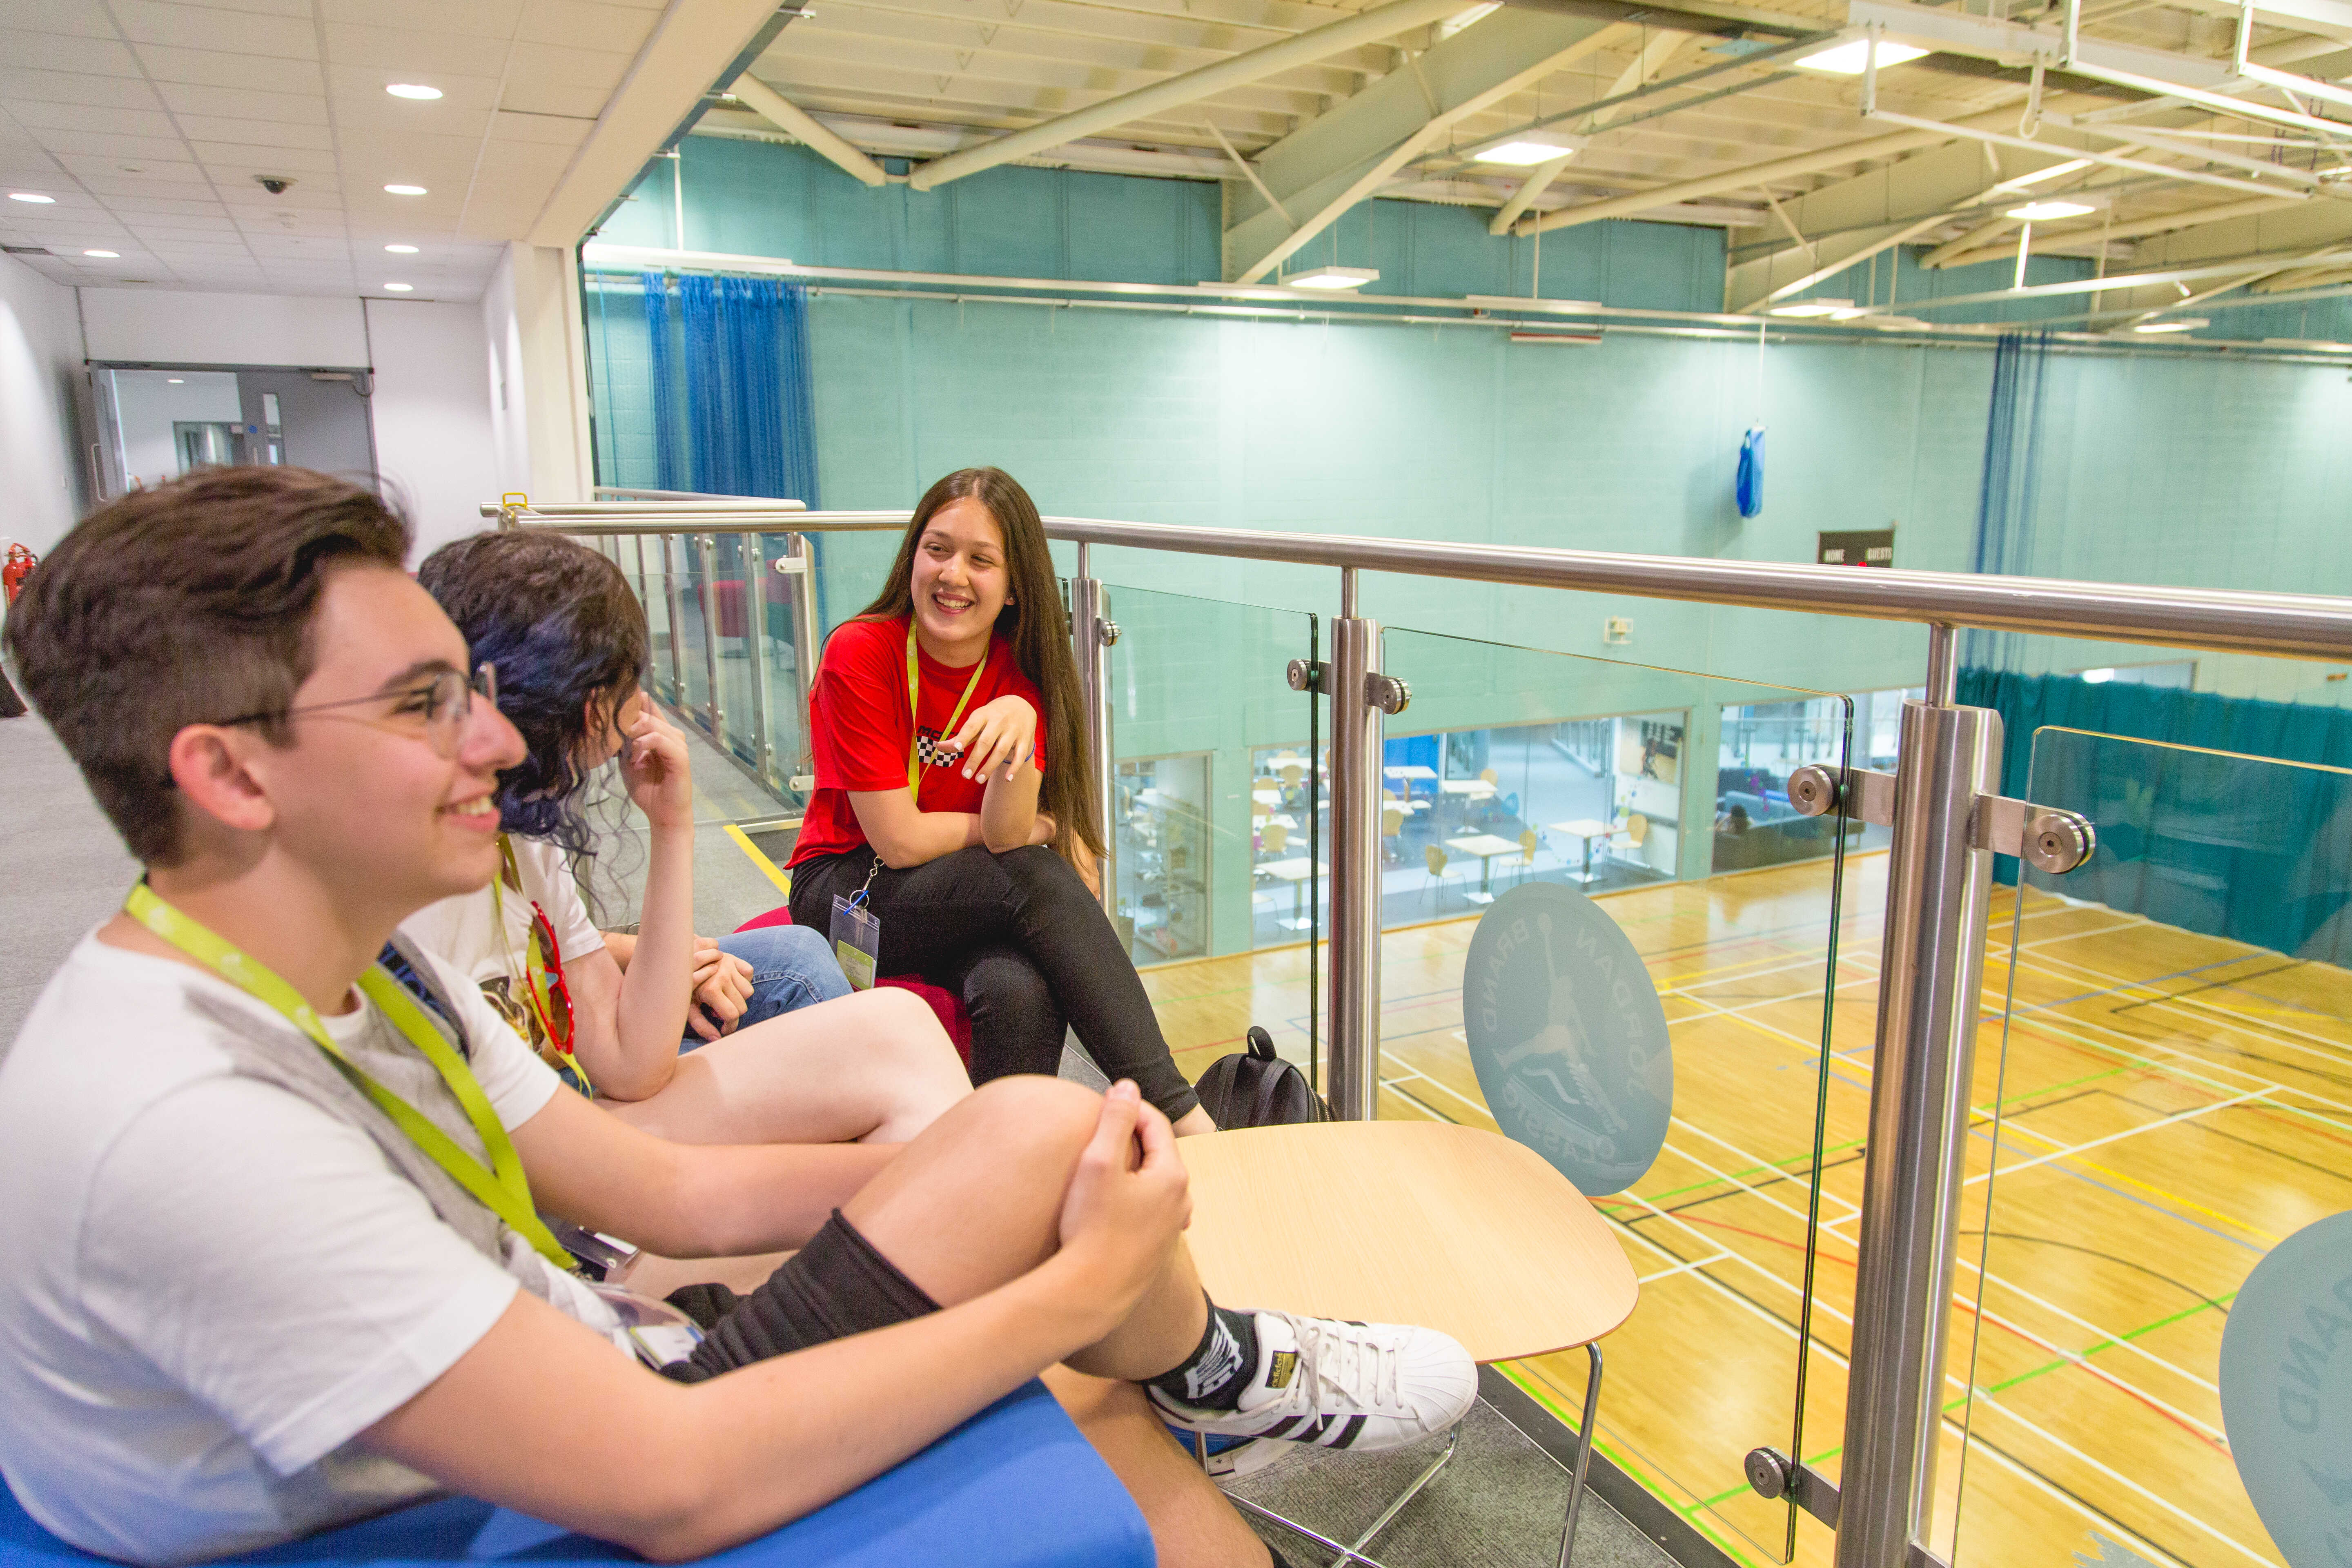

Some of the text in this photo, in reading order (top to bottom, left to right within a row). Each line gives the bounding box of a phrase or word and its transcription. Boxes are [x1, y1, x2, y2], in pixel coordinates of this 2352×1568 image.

[1826, 549, 1844, 563] HOME
[1868, 547, 1893, 560] GUESTS
[1272, 1353, 1283, 1387] adidas
